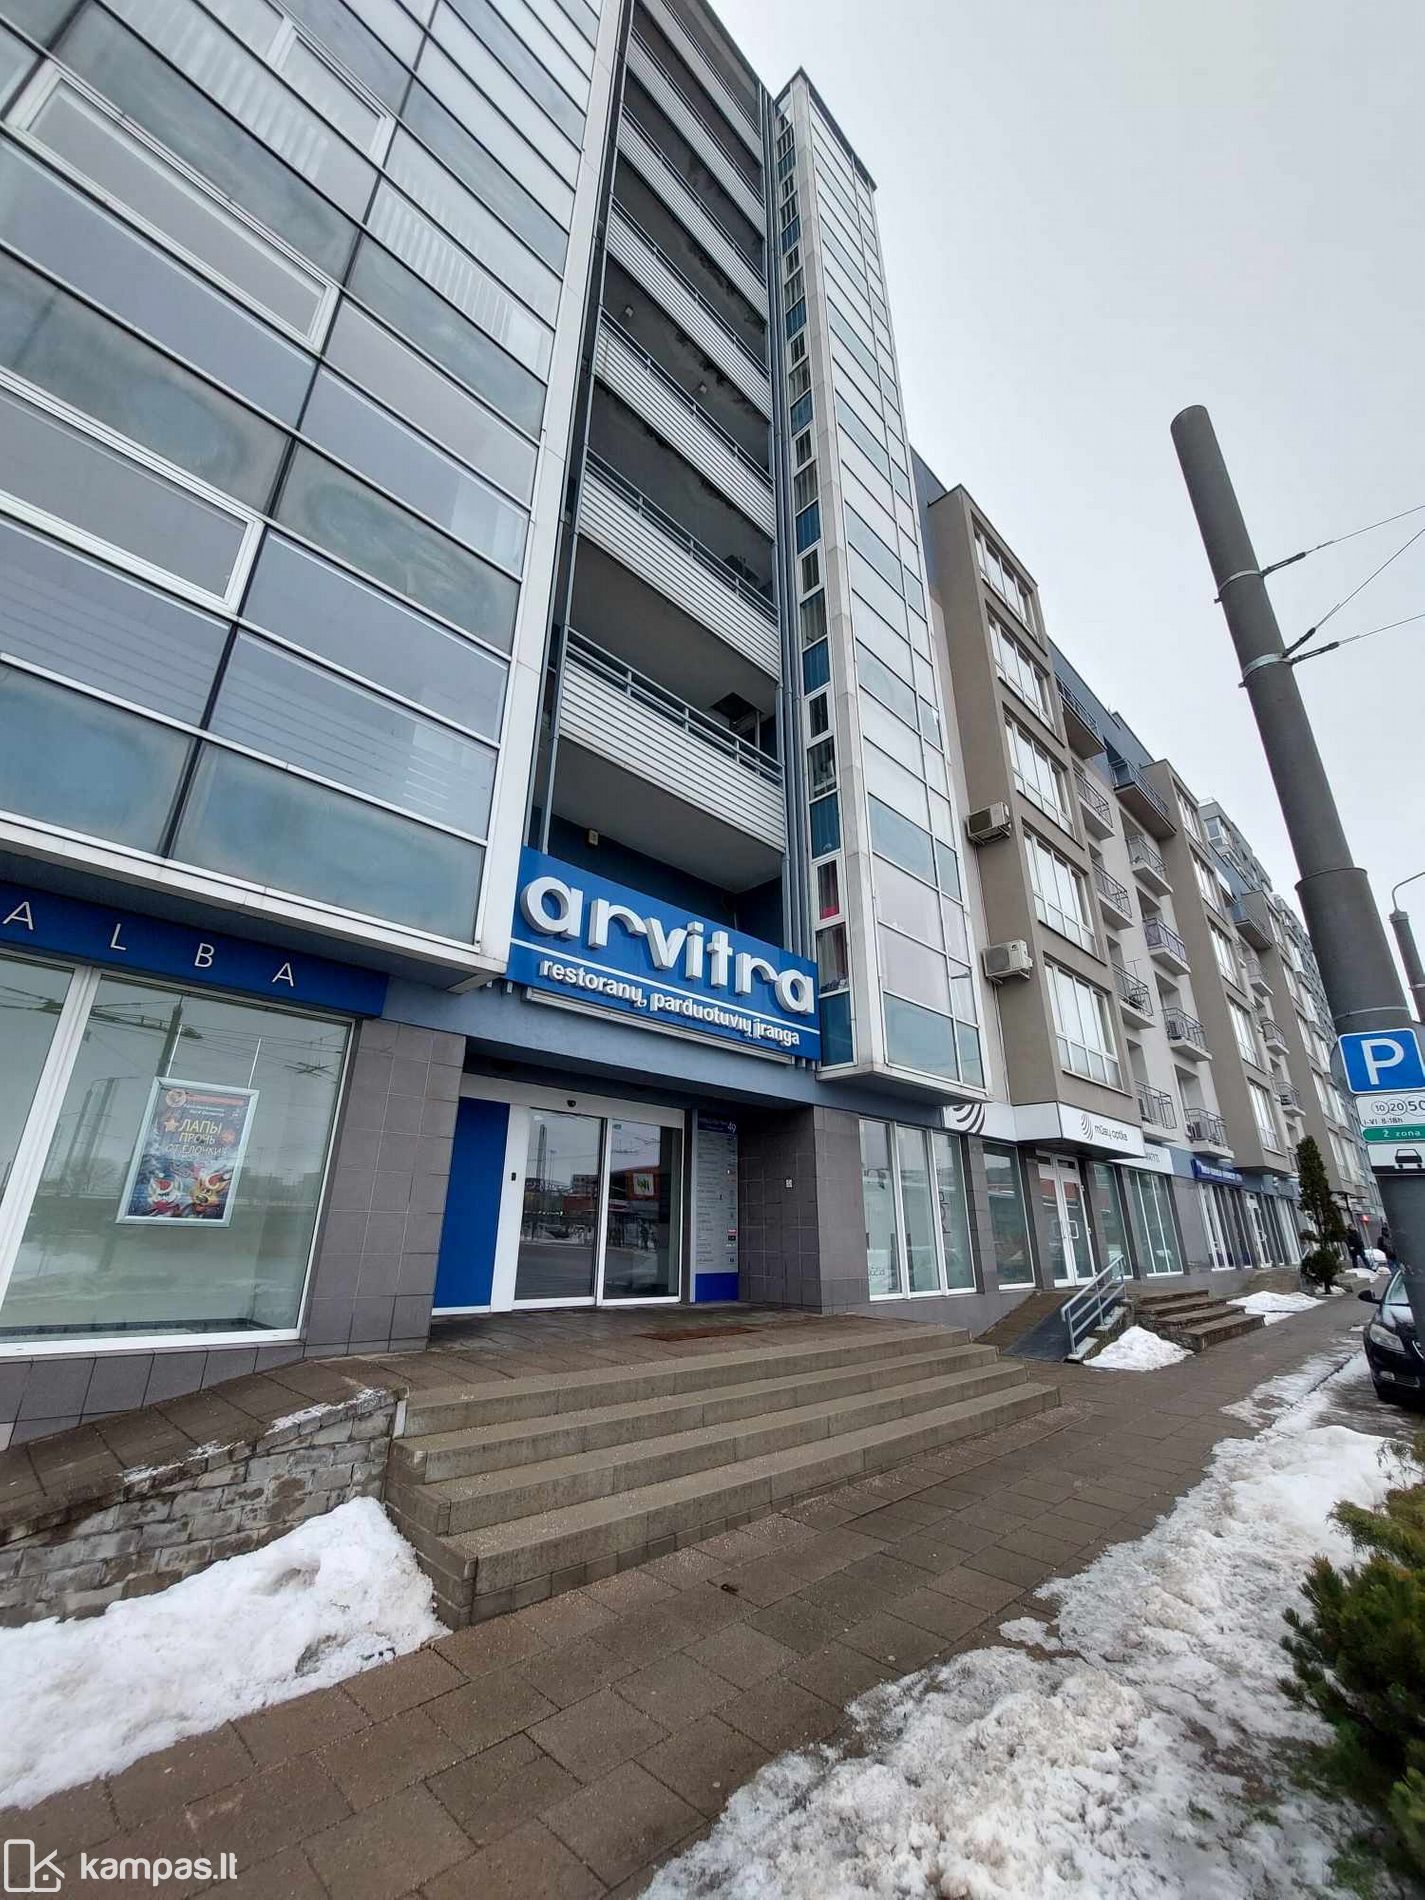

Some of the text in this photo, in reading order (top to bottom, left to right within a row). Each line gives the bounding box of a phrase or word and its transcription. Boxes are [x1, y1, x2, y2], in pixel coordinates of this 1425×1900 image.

[520, 876, 815, 1015] arvitra
[650, 991, 753, 1038] parduotuvių
[752, 1018, 800, 1046] įranga
[1360, 1038, 1404, 1085] P
[1389, 1103, 1404, 1112] 20
[178, 1119, 222, 1134] ЛАПЫ
[1383, 1129, 1389, 1137] 2
[179, 1132, 215, 1145] ПРОЧЬ
